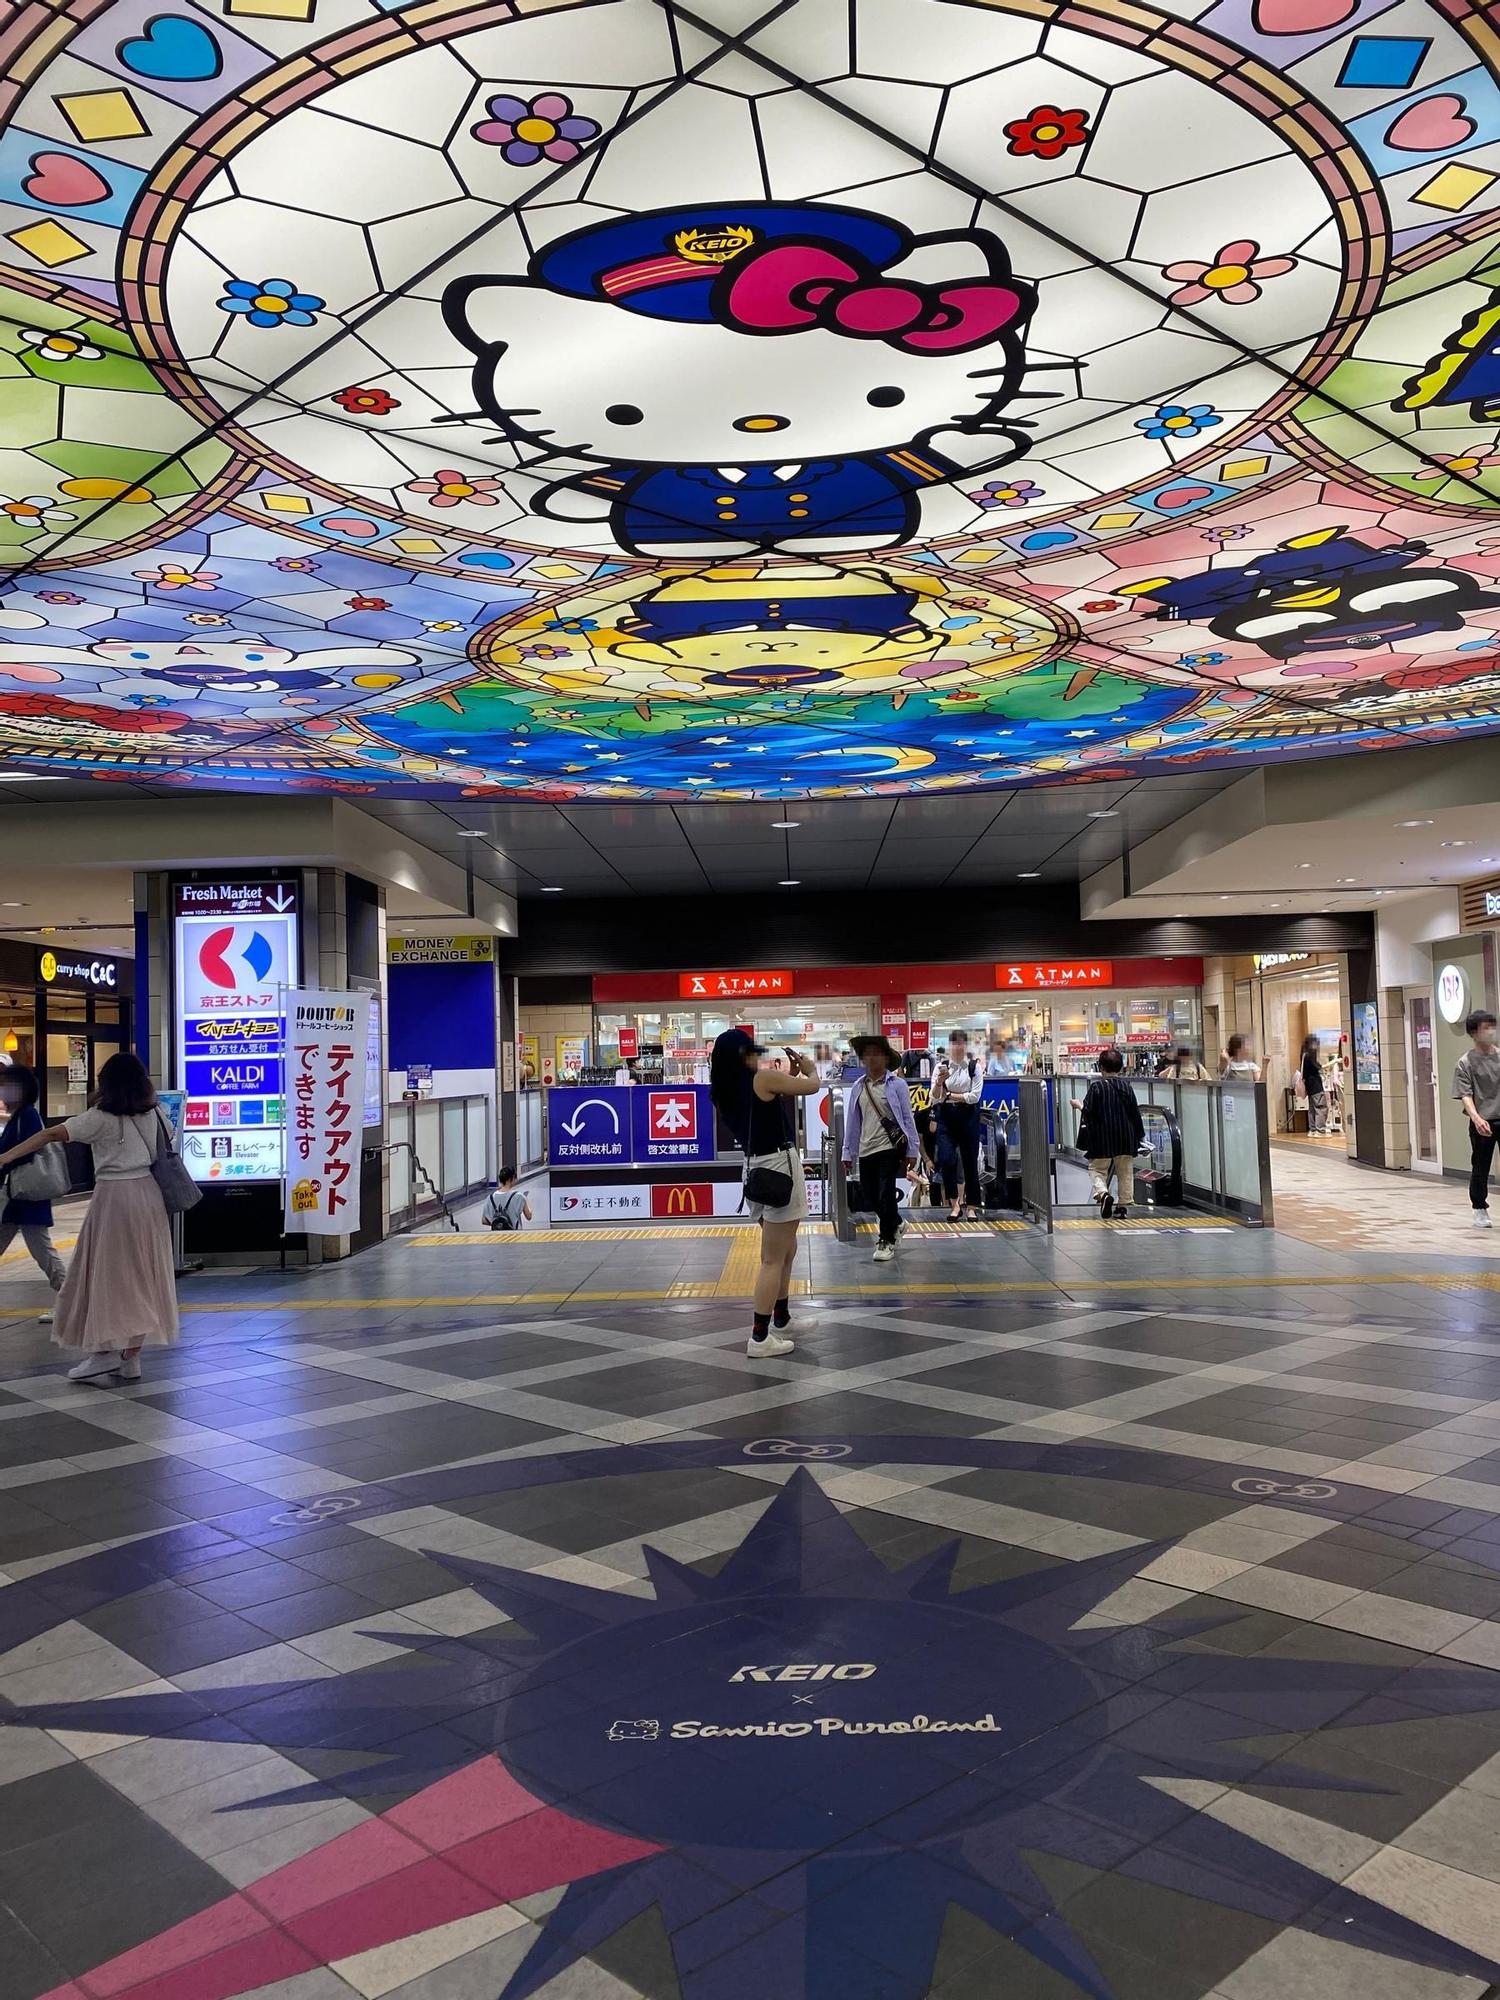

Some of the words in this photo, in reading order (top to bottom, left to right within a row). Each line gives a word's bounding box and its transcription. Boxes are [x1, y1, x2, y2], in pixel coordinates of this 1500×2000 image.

[689, 238, 743, 251] KEIO
[182, 886, 218, 901] Fresh
[219, 885, 262, 899] Market
[405, 939, 453, 949] MONEY
[392, 950, 468, 962] EXCHANGE
[56, 964, 73, 977] curry
[74, 964, 89, 979] shop
[91, 961, 115, 986] C&C
[200, 995, 273, 1008] 京王ストア
[296, 1006, 355, 1022] DOUTOR
[197, 1020, 278, 1039] マツモトキヨシ
[209, 1043, 268, 1055] 処方せん受付
[211, 1065, 265, 1083] KALDI
[293, 1044, 319, 1160] できます
[655, 1098, 690, 1134] 本
[324, 1045, 354, 1215] テイクアウト
[558, 1143, 623, 1156] 反対側改札前
[647, 1143, 700, 1155] 啓文堂書店
[294, 1190, 314, 1200] Take
[580, 1196, 642, 1208] 京王不動産
[298, 1200, 313, 1209] out
[728, 1663, 877, 1683] KEIO
[669, 1720, 812, 1739] Sanrio
[813, 1713, 1002, 1736] Puroland
